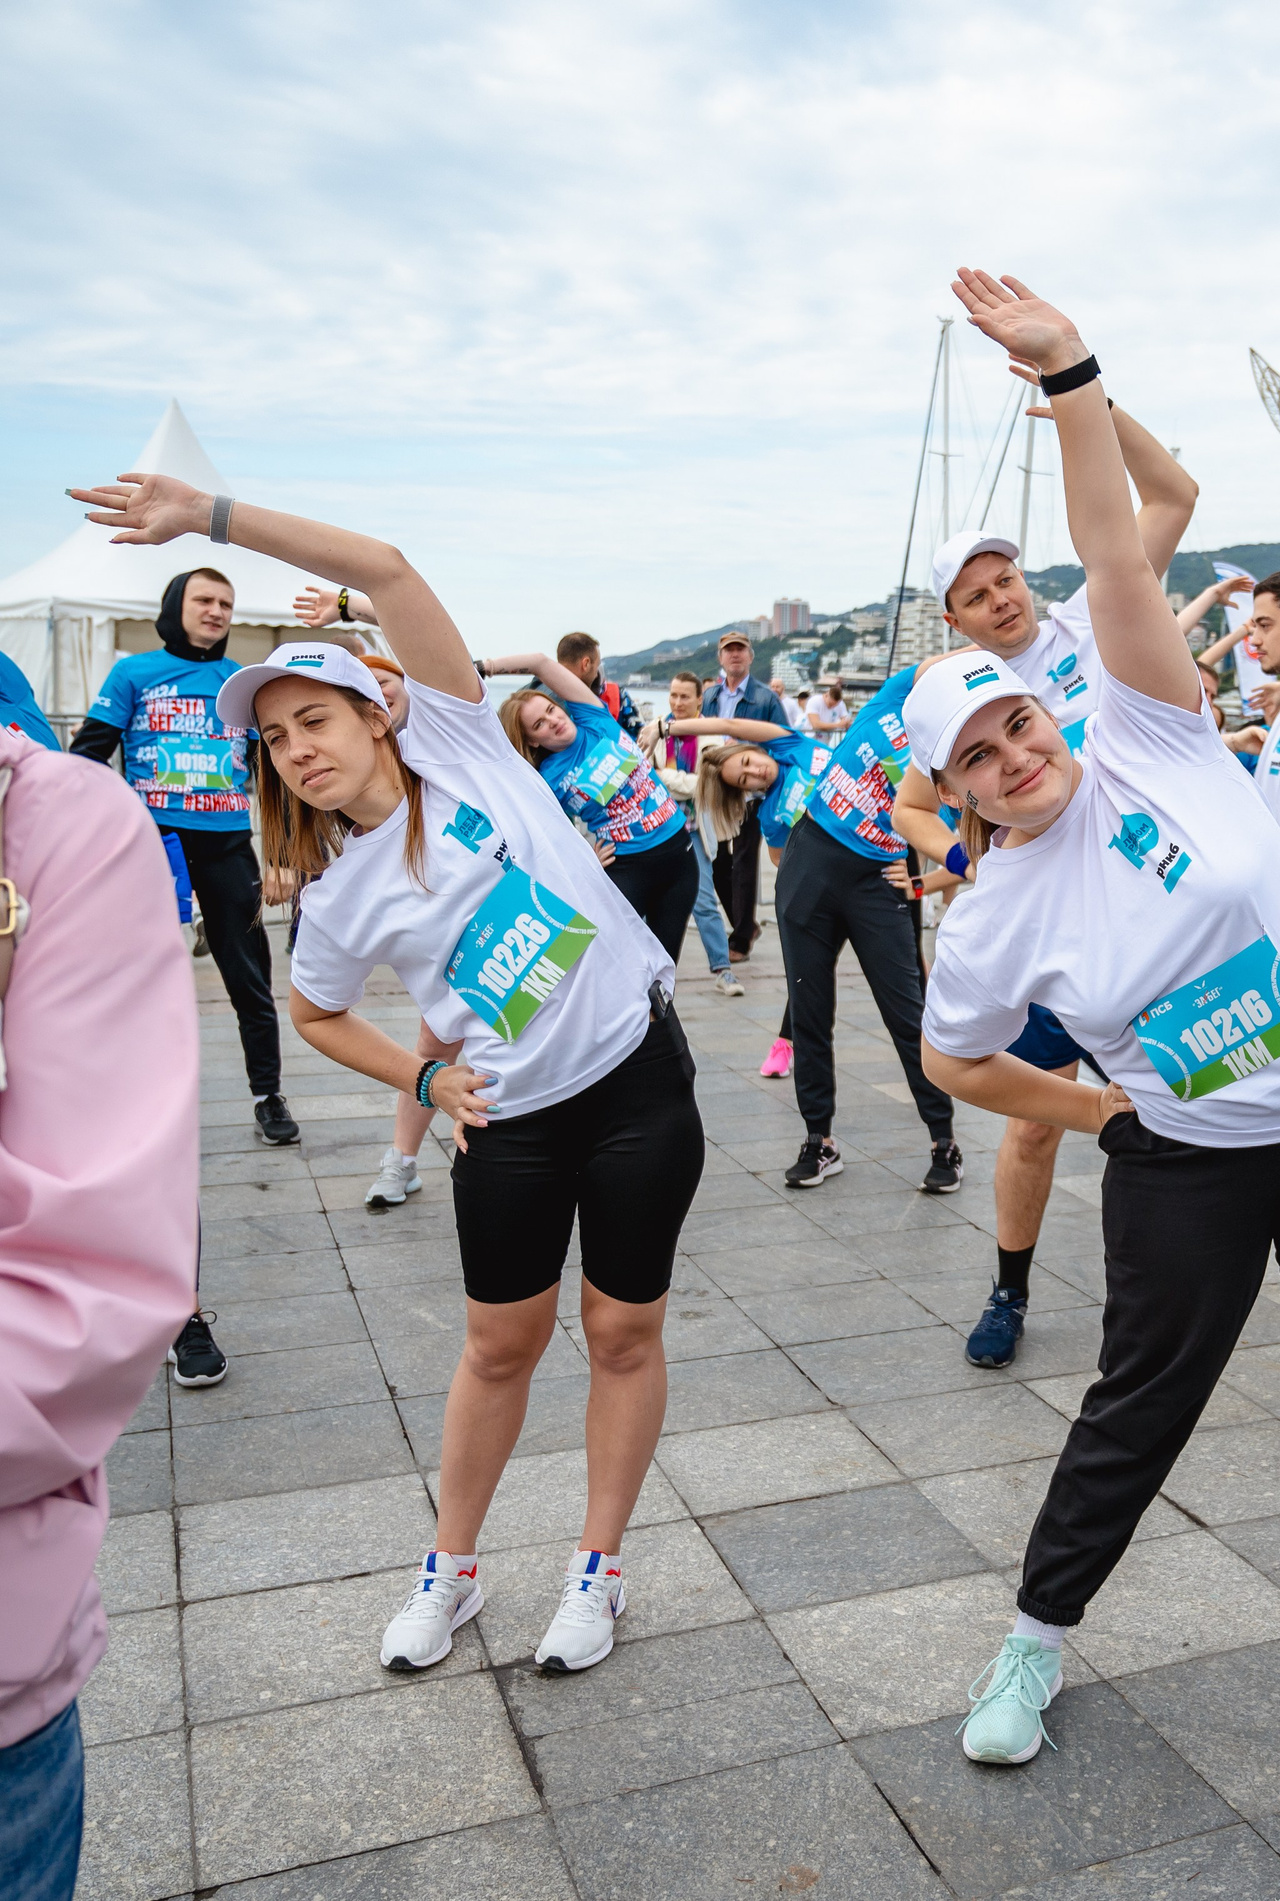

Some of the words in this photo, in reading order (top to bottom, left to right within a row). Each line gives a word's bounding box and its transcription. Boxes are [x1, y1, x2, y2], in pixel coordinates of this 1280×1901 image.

[290, 653, 326, 662] рнкб
[962, 664, 994, 682] рнкб
[1062, 674, 1085, 694] рнкб
[145, 697, 206, 716] #МЕЧТА
[877, 712, 910, 751] #ЗАБ
[173, 751, 218, 773] 10162
[816, 777, 855, 822] #ЗАБЕГ
[828, 763, 883, 822] #ЛЮБОВЬ
[857, 769, 894, 818] #ГОРД
[493, 838, 508, 863] рн
[1156, 842, 1181, 880] рнкб
[452, 950, 465, 971] ПСБ
[477, 912, 551, 1000] 10226
[519, 955, 568, 1004] 1КМ
[1150, 1000, 1173, 1020] ПСБ
[1179, 988, 1273, 1063] 10216
[1221, 1035, 1275, 1081] 1КМ
